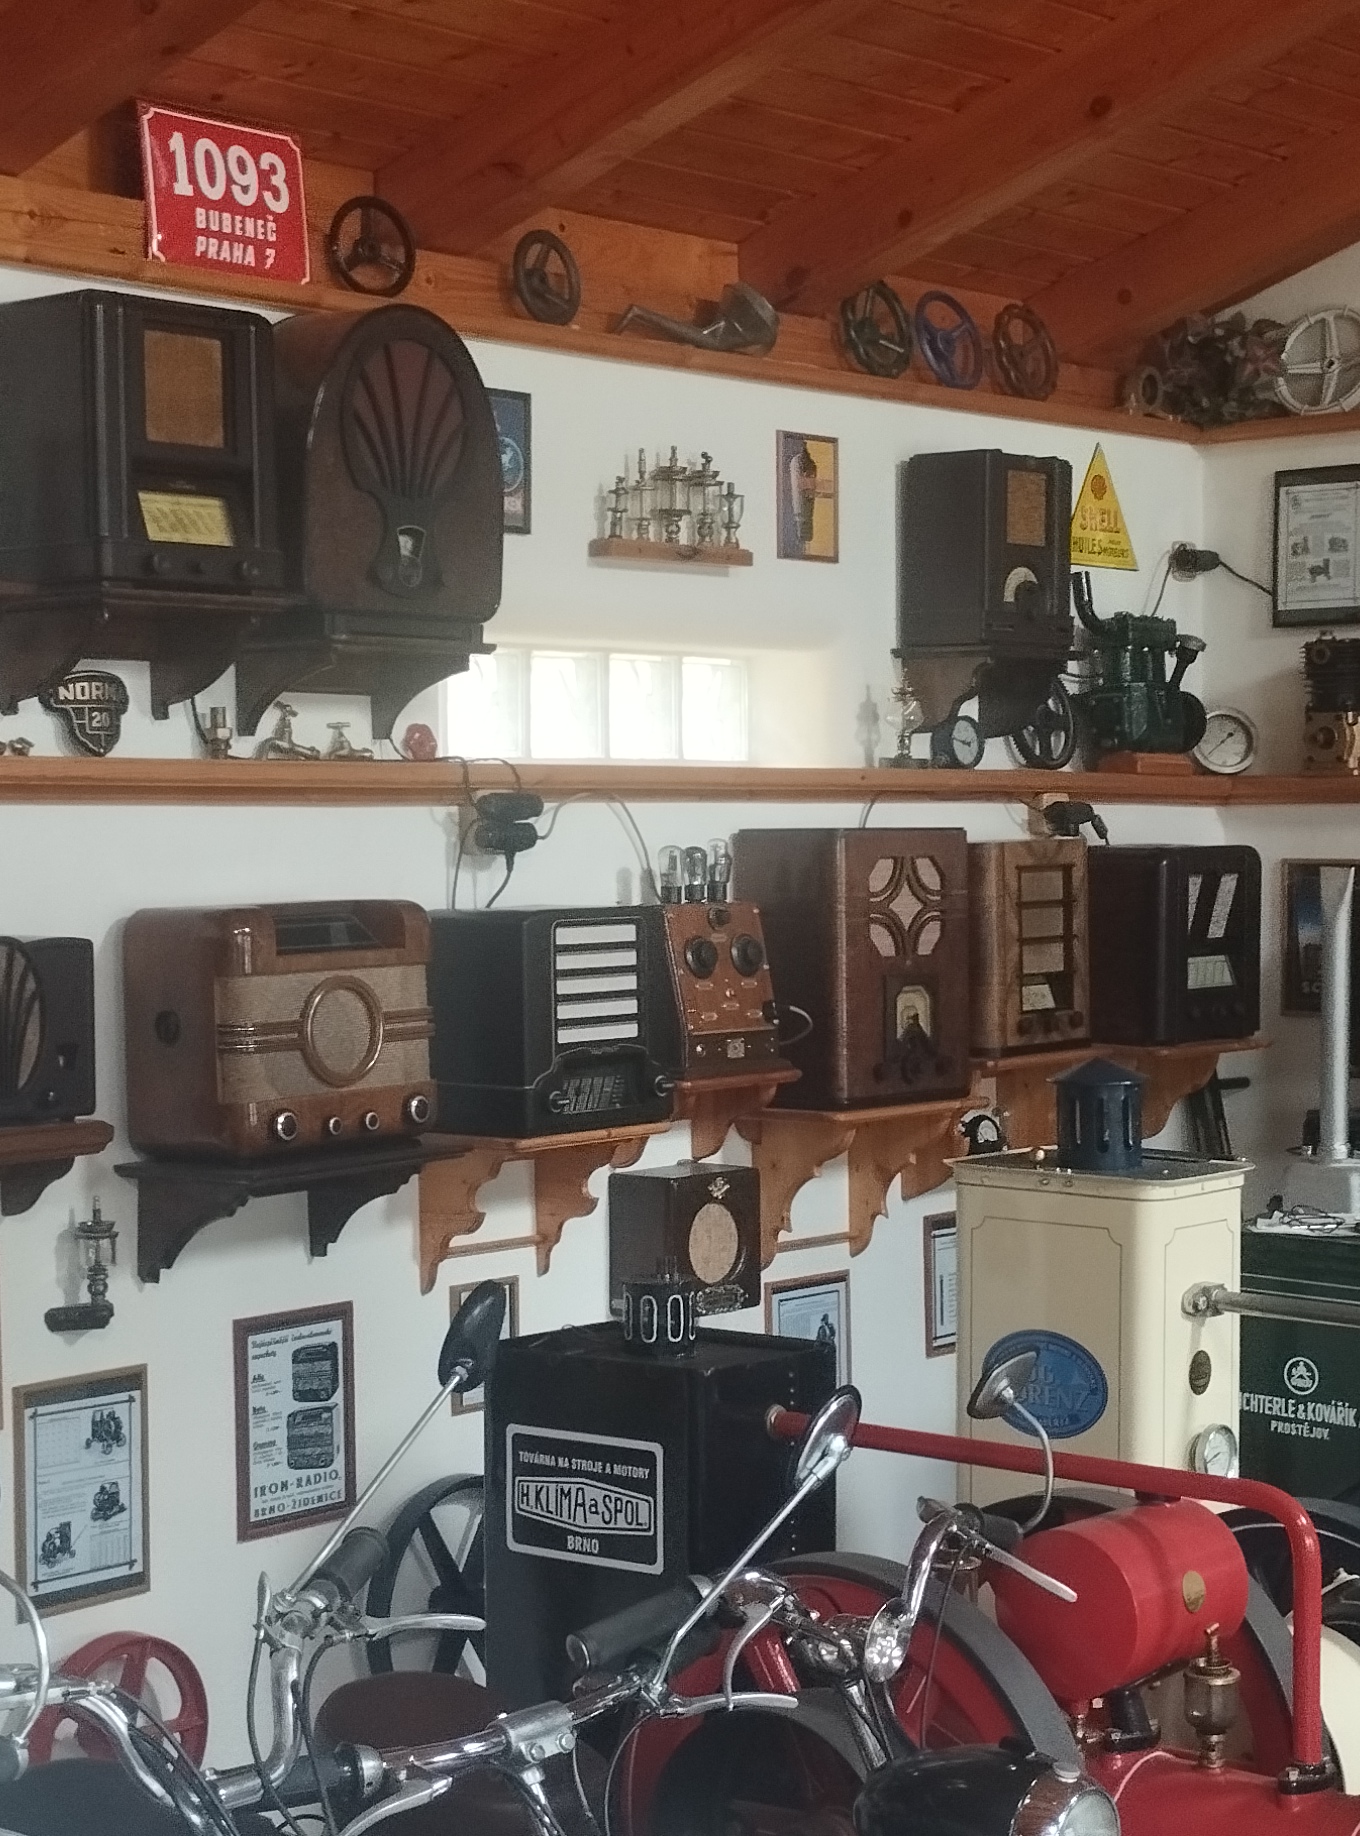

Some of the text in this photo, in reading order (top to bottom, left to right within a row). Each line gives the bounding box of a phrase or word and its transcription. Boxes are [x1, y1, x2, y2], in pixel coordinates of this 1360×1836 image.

[168, 131, 290, 214] 1093
[195, 207, 277, 242] BUBENEČ
[195, 236, 276, 269] PRAHA 7
[1080, 505, 1121, 534] SHELL
[92, 711, 110, 727] 20
[519, 1450, 651, 1480] TOVÁRNA NA STROJE A MOTORY
[534, 1483, 588, 1525] KLÍMA
[601, 1493, 648, 1527] SPOL.
[566, 1535, 600, 1555] BRNO
